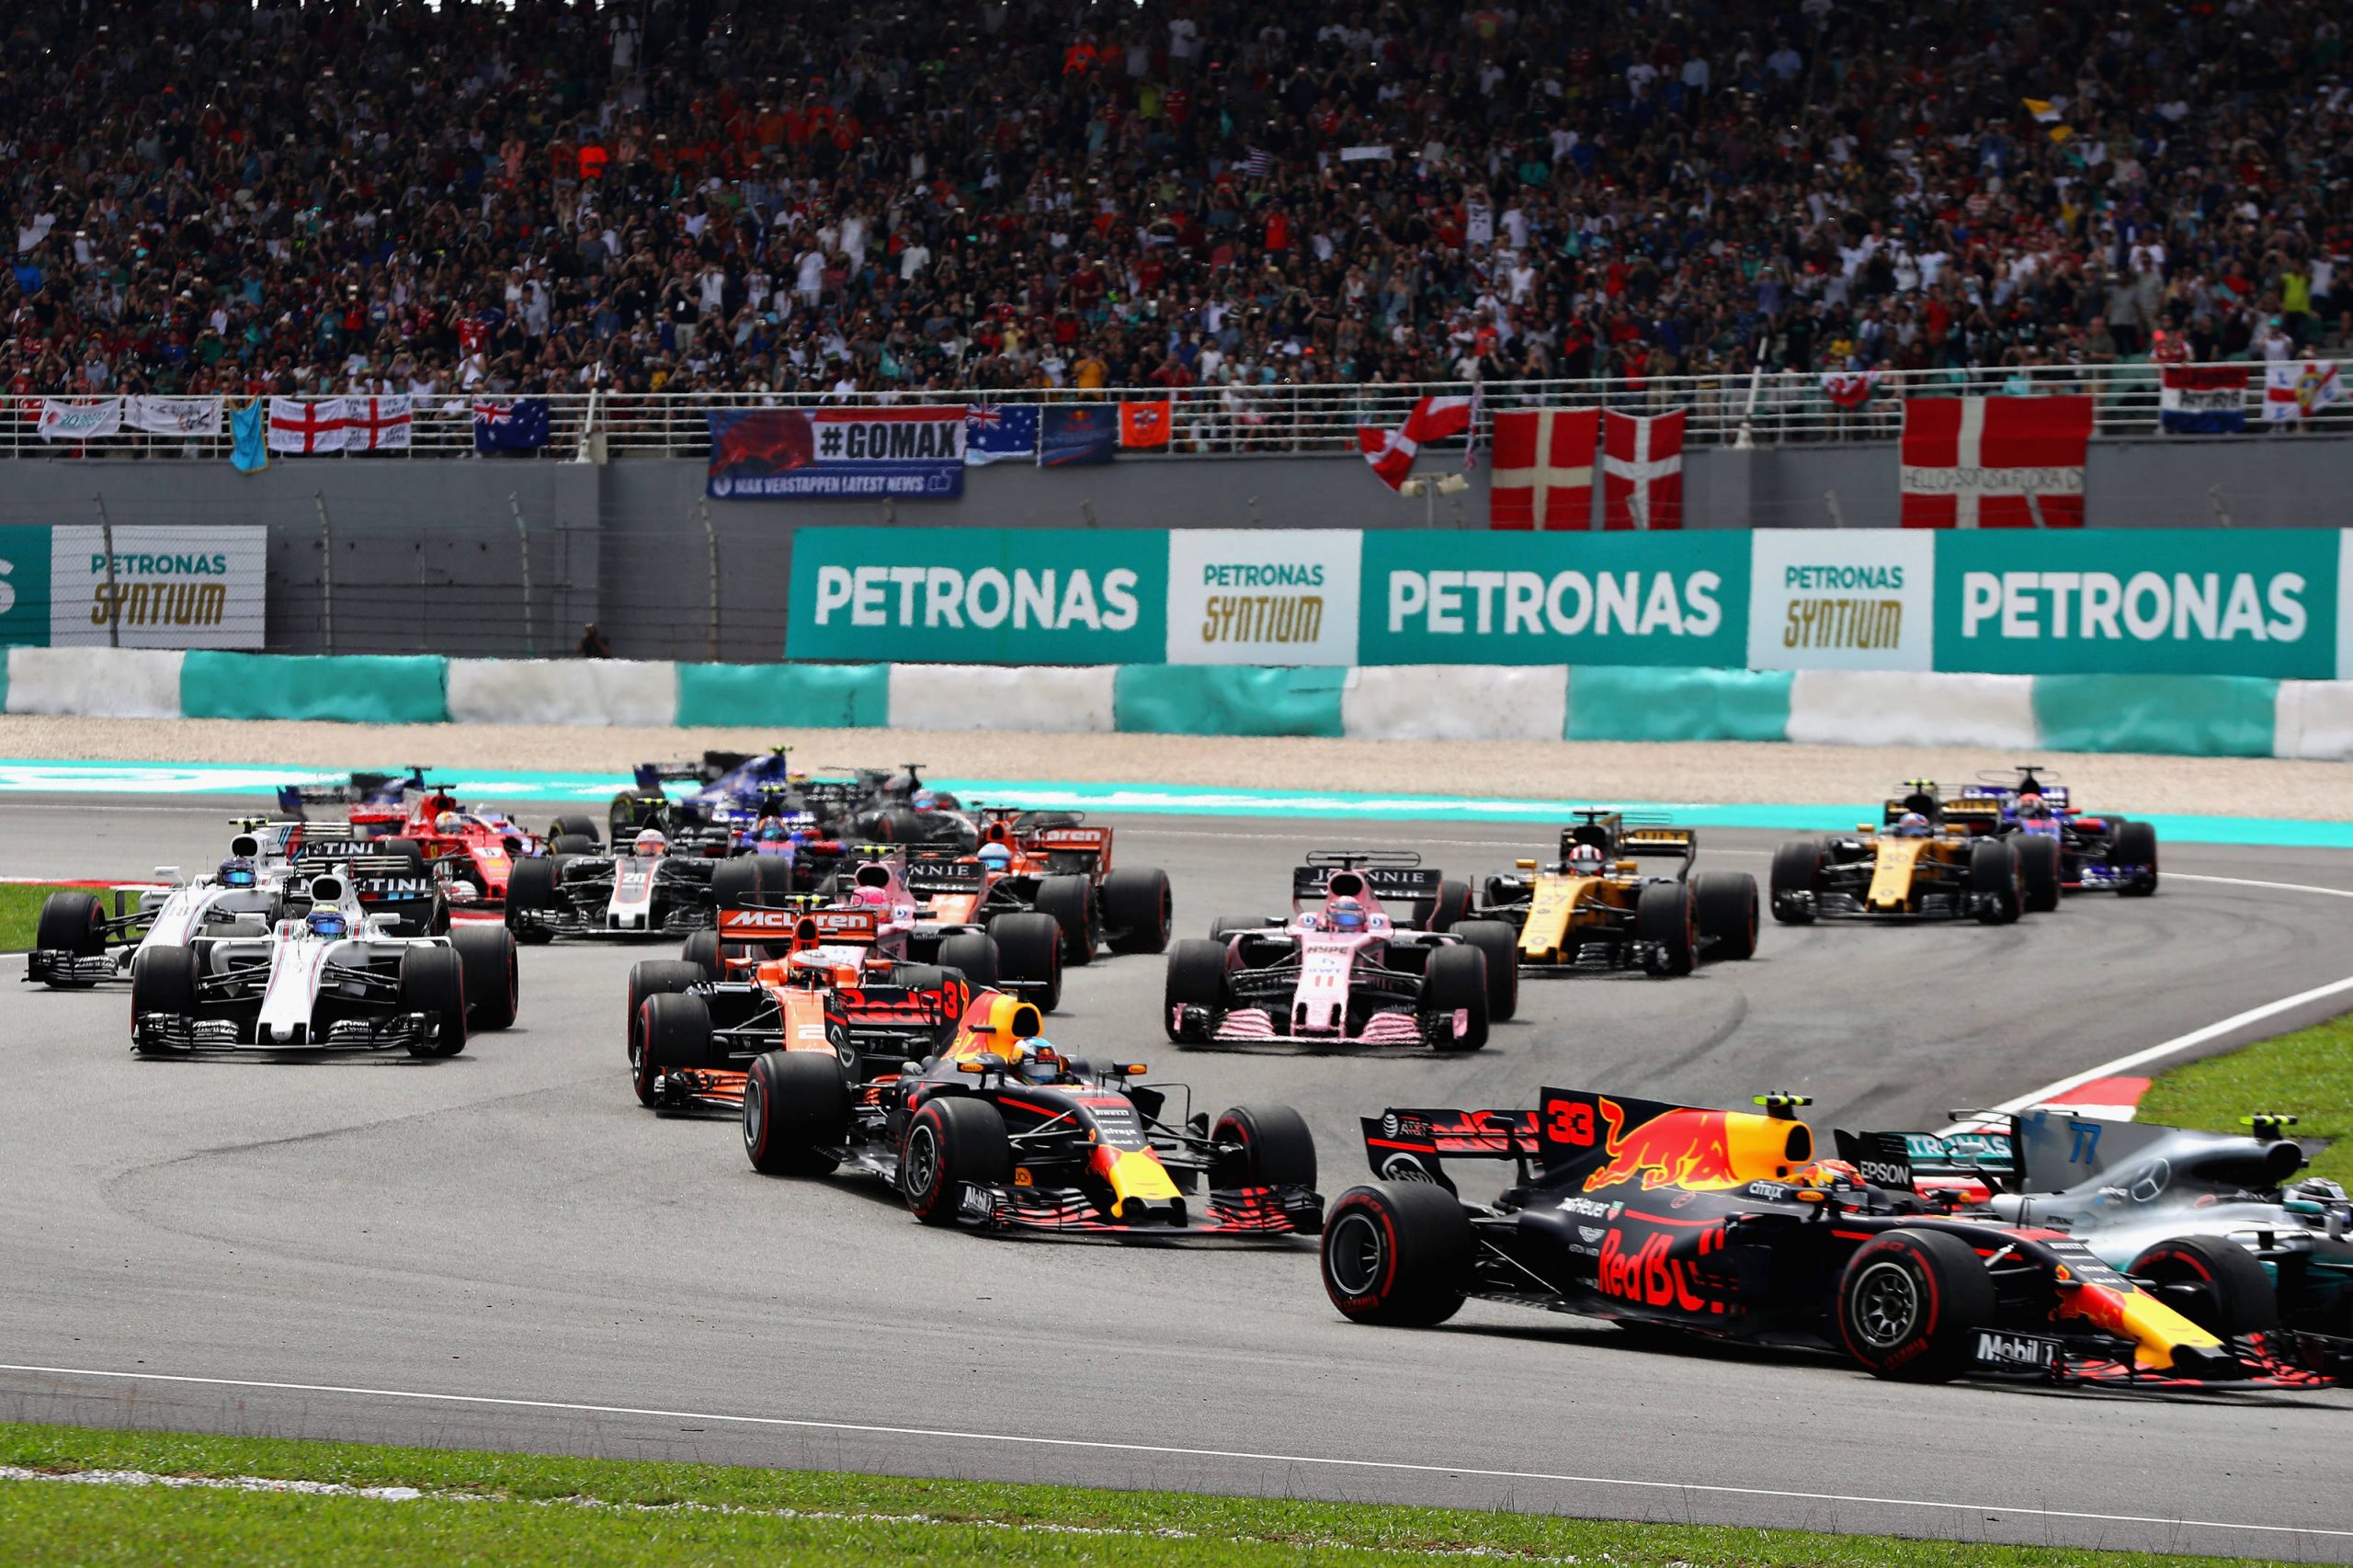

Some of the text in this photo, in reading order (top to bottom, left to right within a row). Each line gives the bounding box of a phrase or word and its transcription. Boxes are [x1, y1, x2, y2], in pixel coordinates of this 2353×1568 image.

[820, 422, 957, 460] #GOMAX
[735, 475, 925, 494] MAX VERSTAPPEN LATEST NEWS
[91, 554, 226, 574] PETRONAS
[1203, 563, 1324, 586] PETRONAS
[1785, 566, 1904, 589] PETRONAS
[92, 583, 226, 625] SYNTIUM
[815, 565, 1139, 631] PETRONAS
[1388, 569, 1722, 636] PETRONAS
[1962, 571, 2308, 642] PETRONAS
[1201, 596, 1324, 643] SYNTIUM
[1784, 598, 1903, 648] SYNTIUM
[909, 865, 970, 876] NNIE
[1313, 869, 1426, 883] JNNIE
[300, 878, 426, 892] MTINI
[727, 911, 868, 928] McLren
[1307, 945, 1349, 955] HYPE
[1314, 975, 1335, 987] 11
[943, 980, 959, 1019] 3
[797, 1024, 825, 1040] 2
[1547, 1099, 1595, 1146] 33
[2070, 1122, 2102, 1165] 77
[1860, 1160, 1909, 1185] EPSON
[1977, 1333, 2053, 1367] Mobil 1
